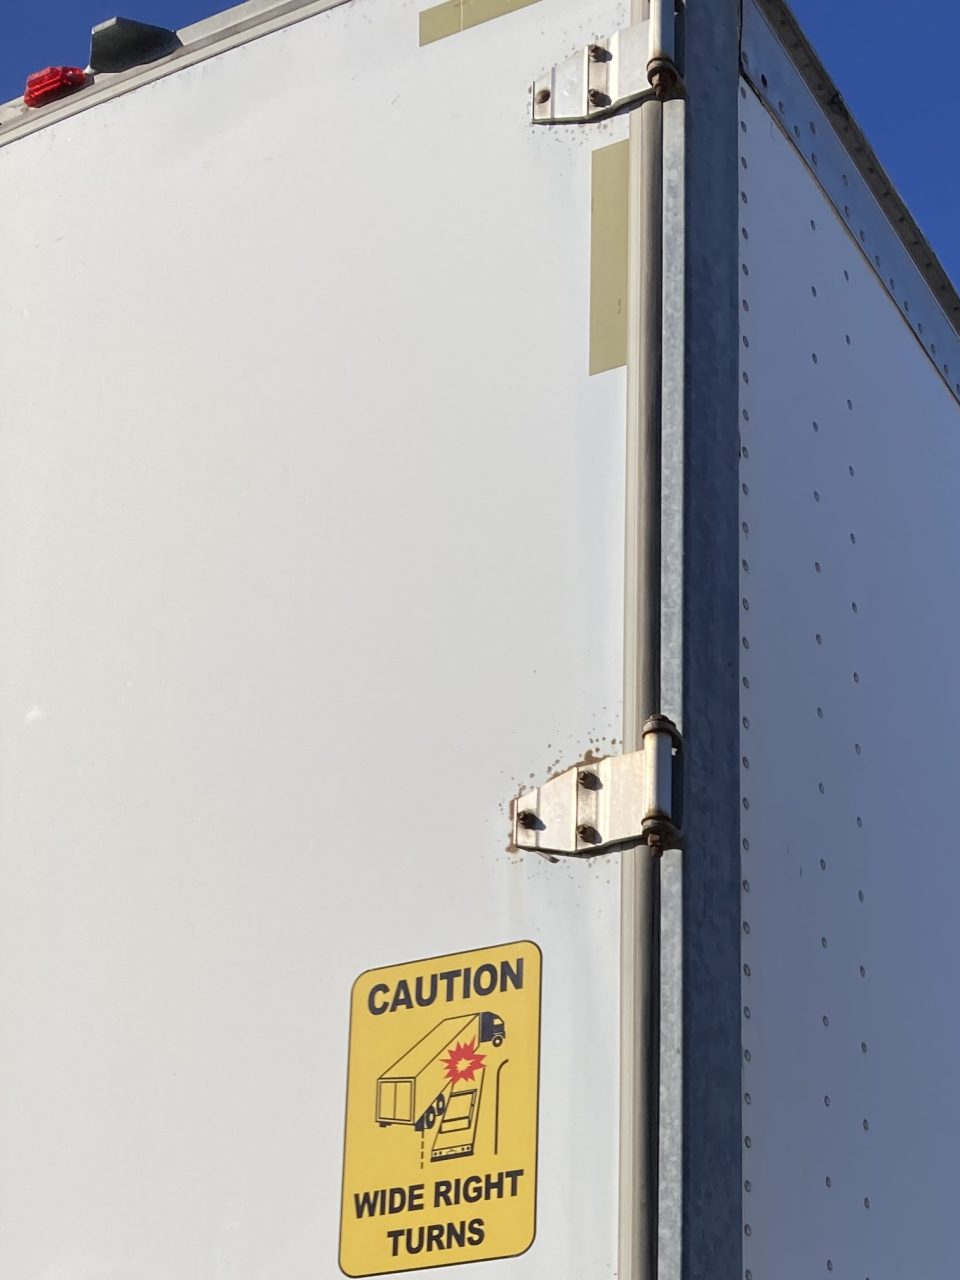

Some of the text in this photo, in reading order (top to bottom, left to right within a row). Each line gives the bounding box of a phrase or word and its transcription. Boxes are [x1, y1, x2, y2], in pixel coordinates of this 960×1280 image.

[367, 957, 525, 1016] CAUTION
[353, 1169, 525, 1219] WIDE RIGHT
[386, 1218, 486, 1257] TURNS
